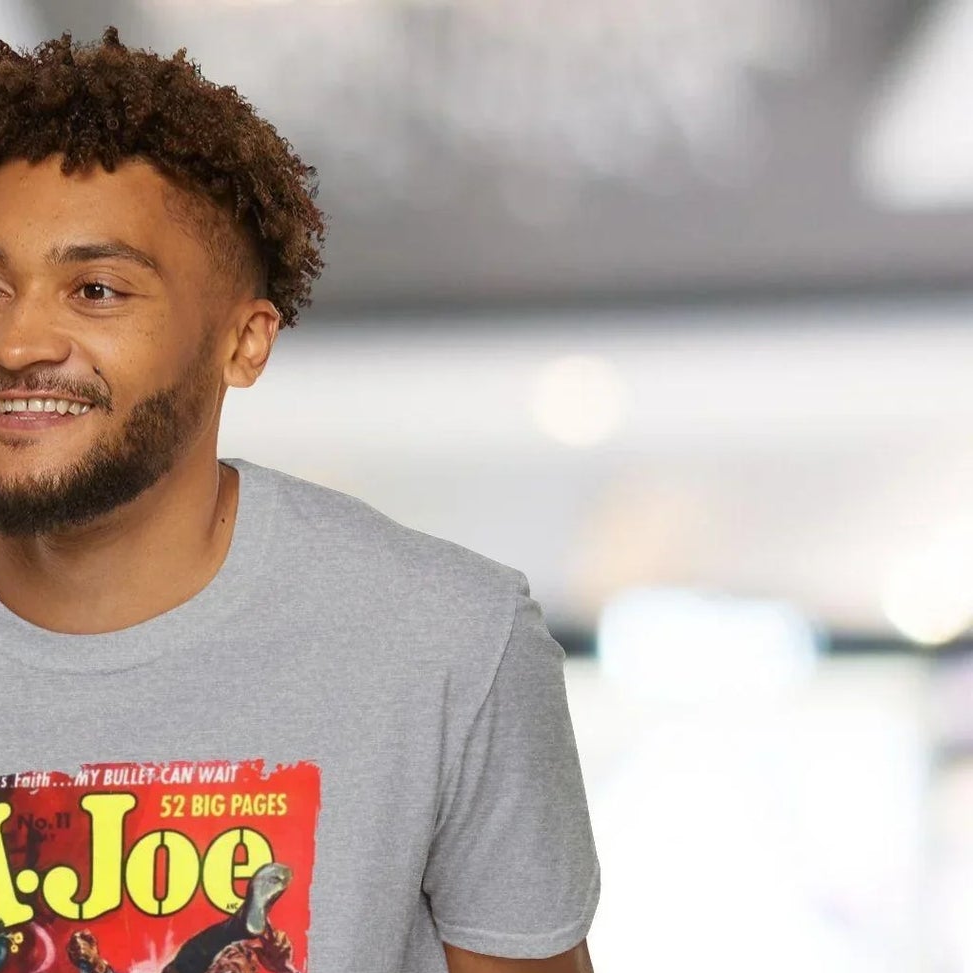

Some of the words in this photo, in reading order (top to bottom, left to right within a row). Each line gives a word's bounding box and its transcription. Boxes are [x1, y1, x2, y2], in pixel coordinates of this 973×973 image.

[103, 767, 154, 786] BULLET
[160, 766, 194, 785] CAN
[197, 765, 240, 784] WAIT
[159, 794, 186, 818] 52
[190, 794, 226, 817] BIG
[230, 793, 289, 817] PAGES
[42, 791, 275, 921] Joe
